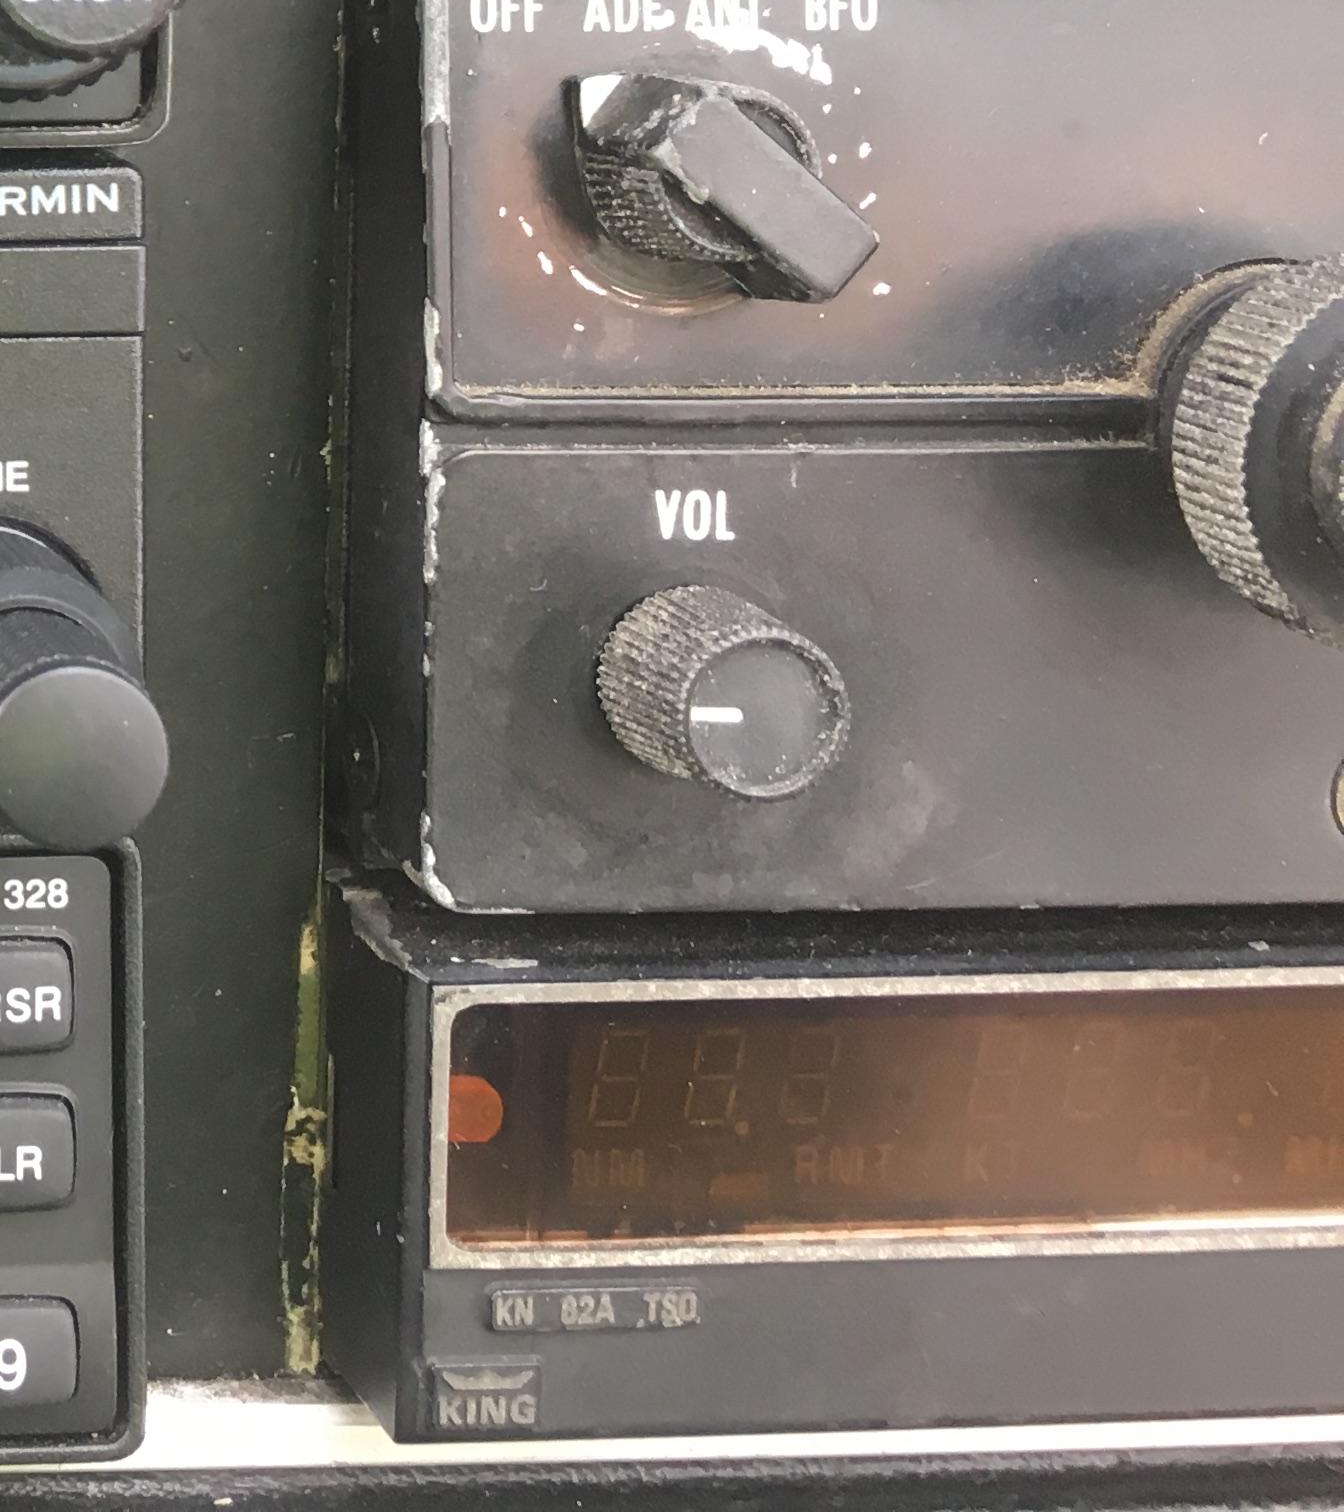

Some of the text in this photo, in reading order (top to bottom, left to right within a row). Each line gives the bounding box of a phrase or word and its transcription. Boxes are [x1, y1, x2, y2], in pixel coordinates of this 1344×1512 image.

[654, 489, 736, 541] VOL
[3, 877, 69, 910] 328
[496, 1296, 534, 1326] KN
[438, 1394, 537, 1426] KING
